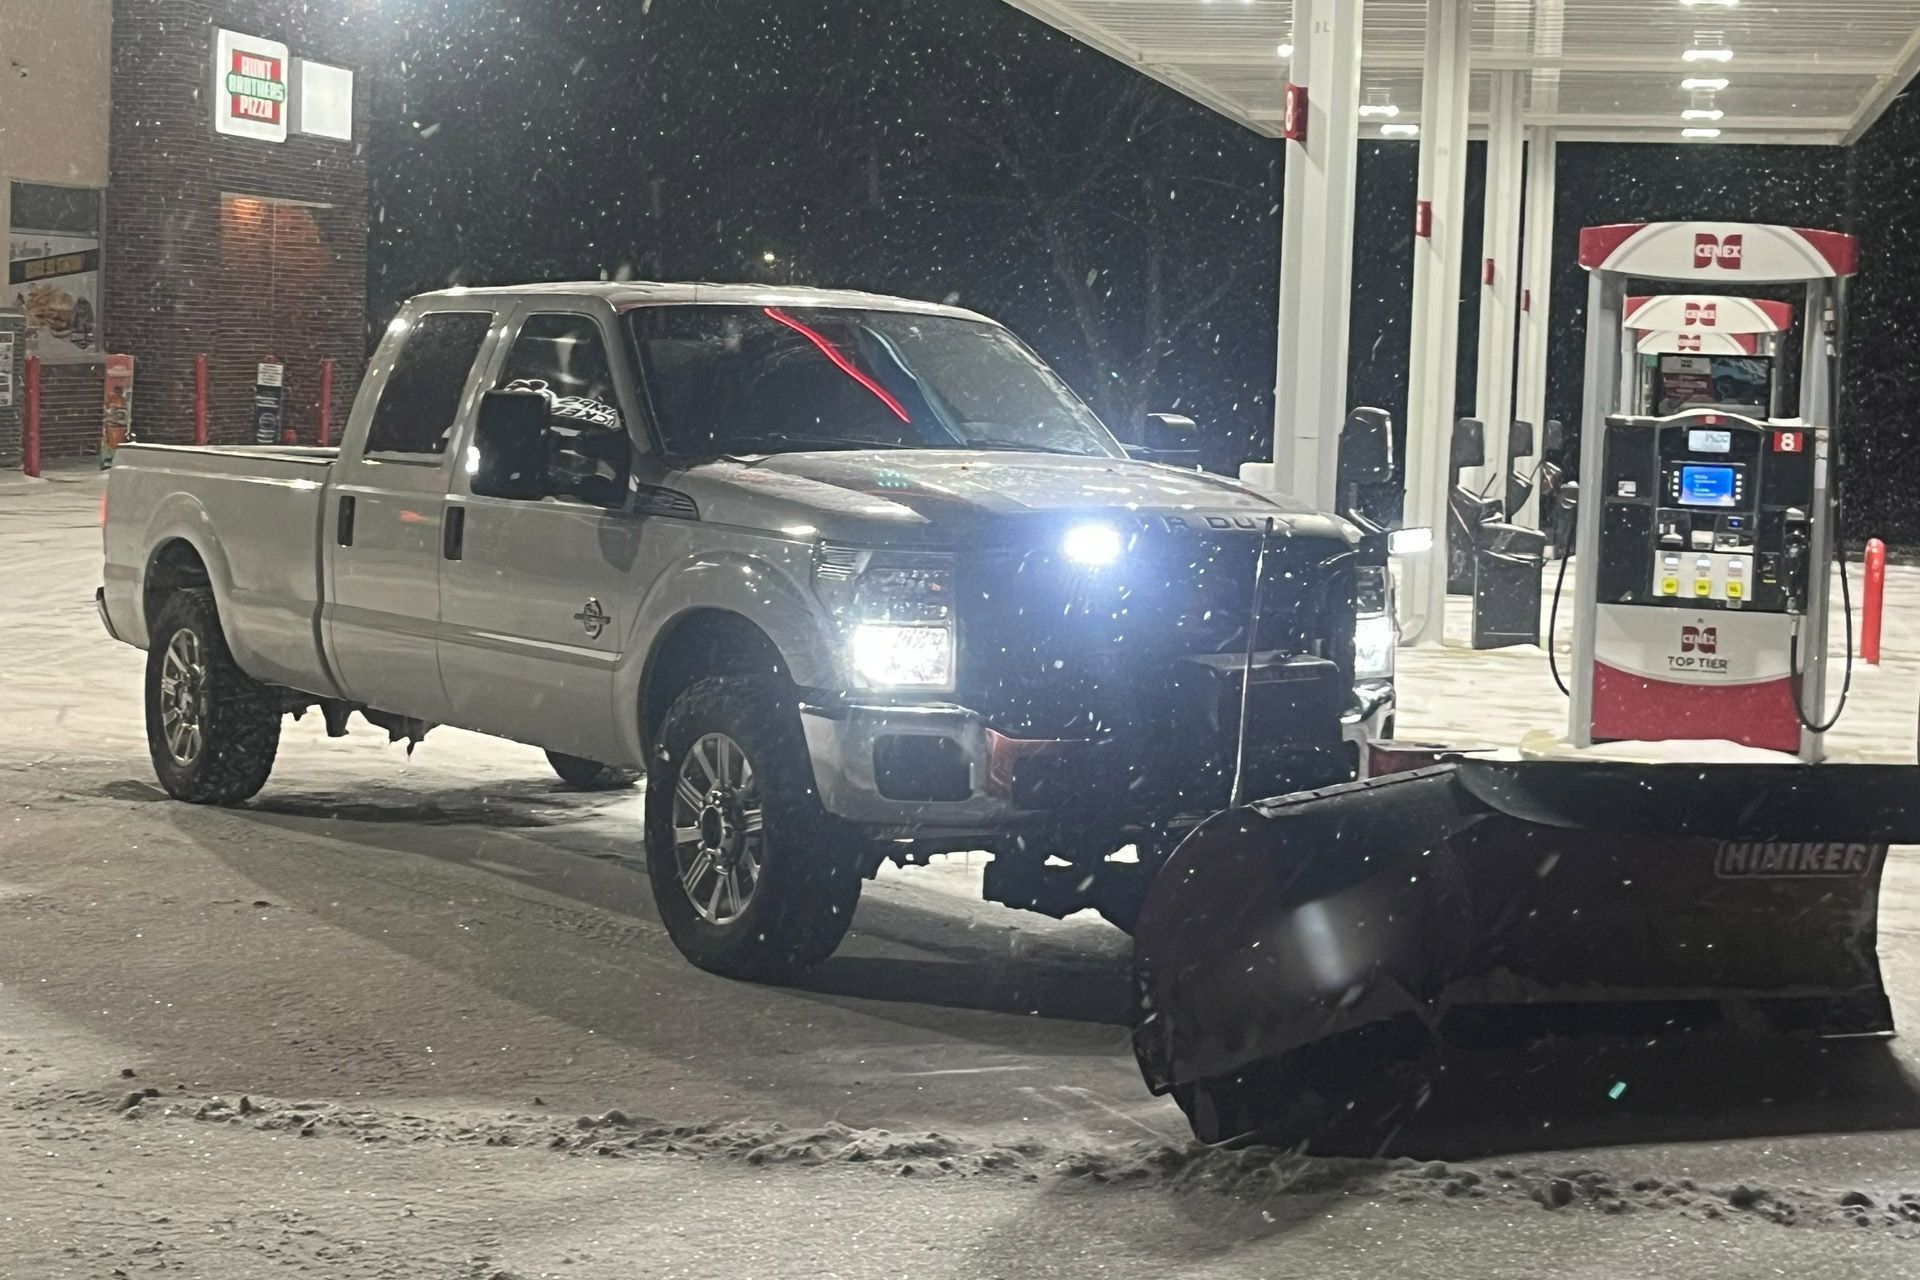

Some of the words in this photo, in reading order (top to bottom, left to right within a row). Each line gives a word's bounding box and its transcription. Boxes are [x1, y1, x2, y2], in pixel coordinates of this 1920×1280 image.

[240, 94, 272, 119] PIZZA
[1695, 243, 1742, 258] CENEX
[1781, 432, 1795, 451] 8
[1667, 655, 1696, 667] TOP
[1698, 657, 1729, 669] TIER
[1723, 842, 1867, 872] HINIKER
